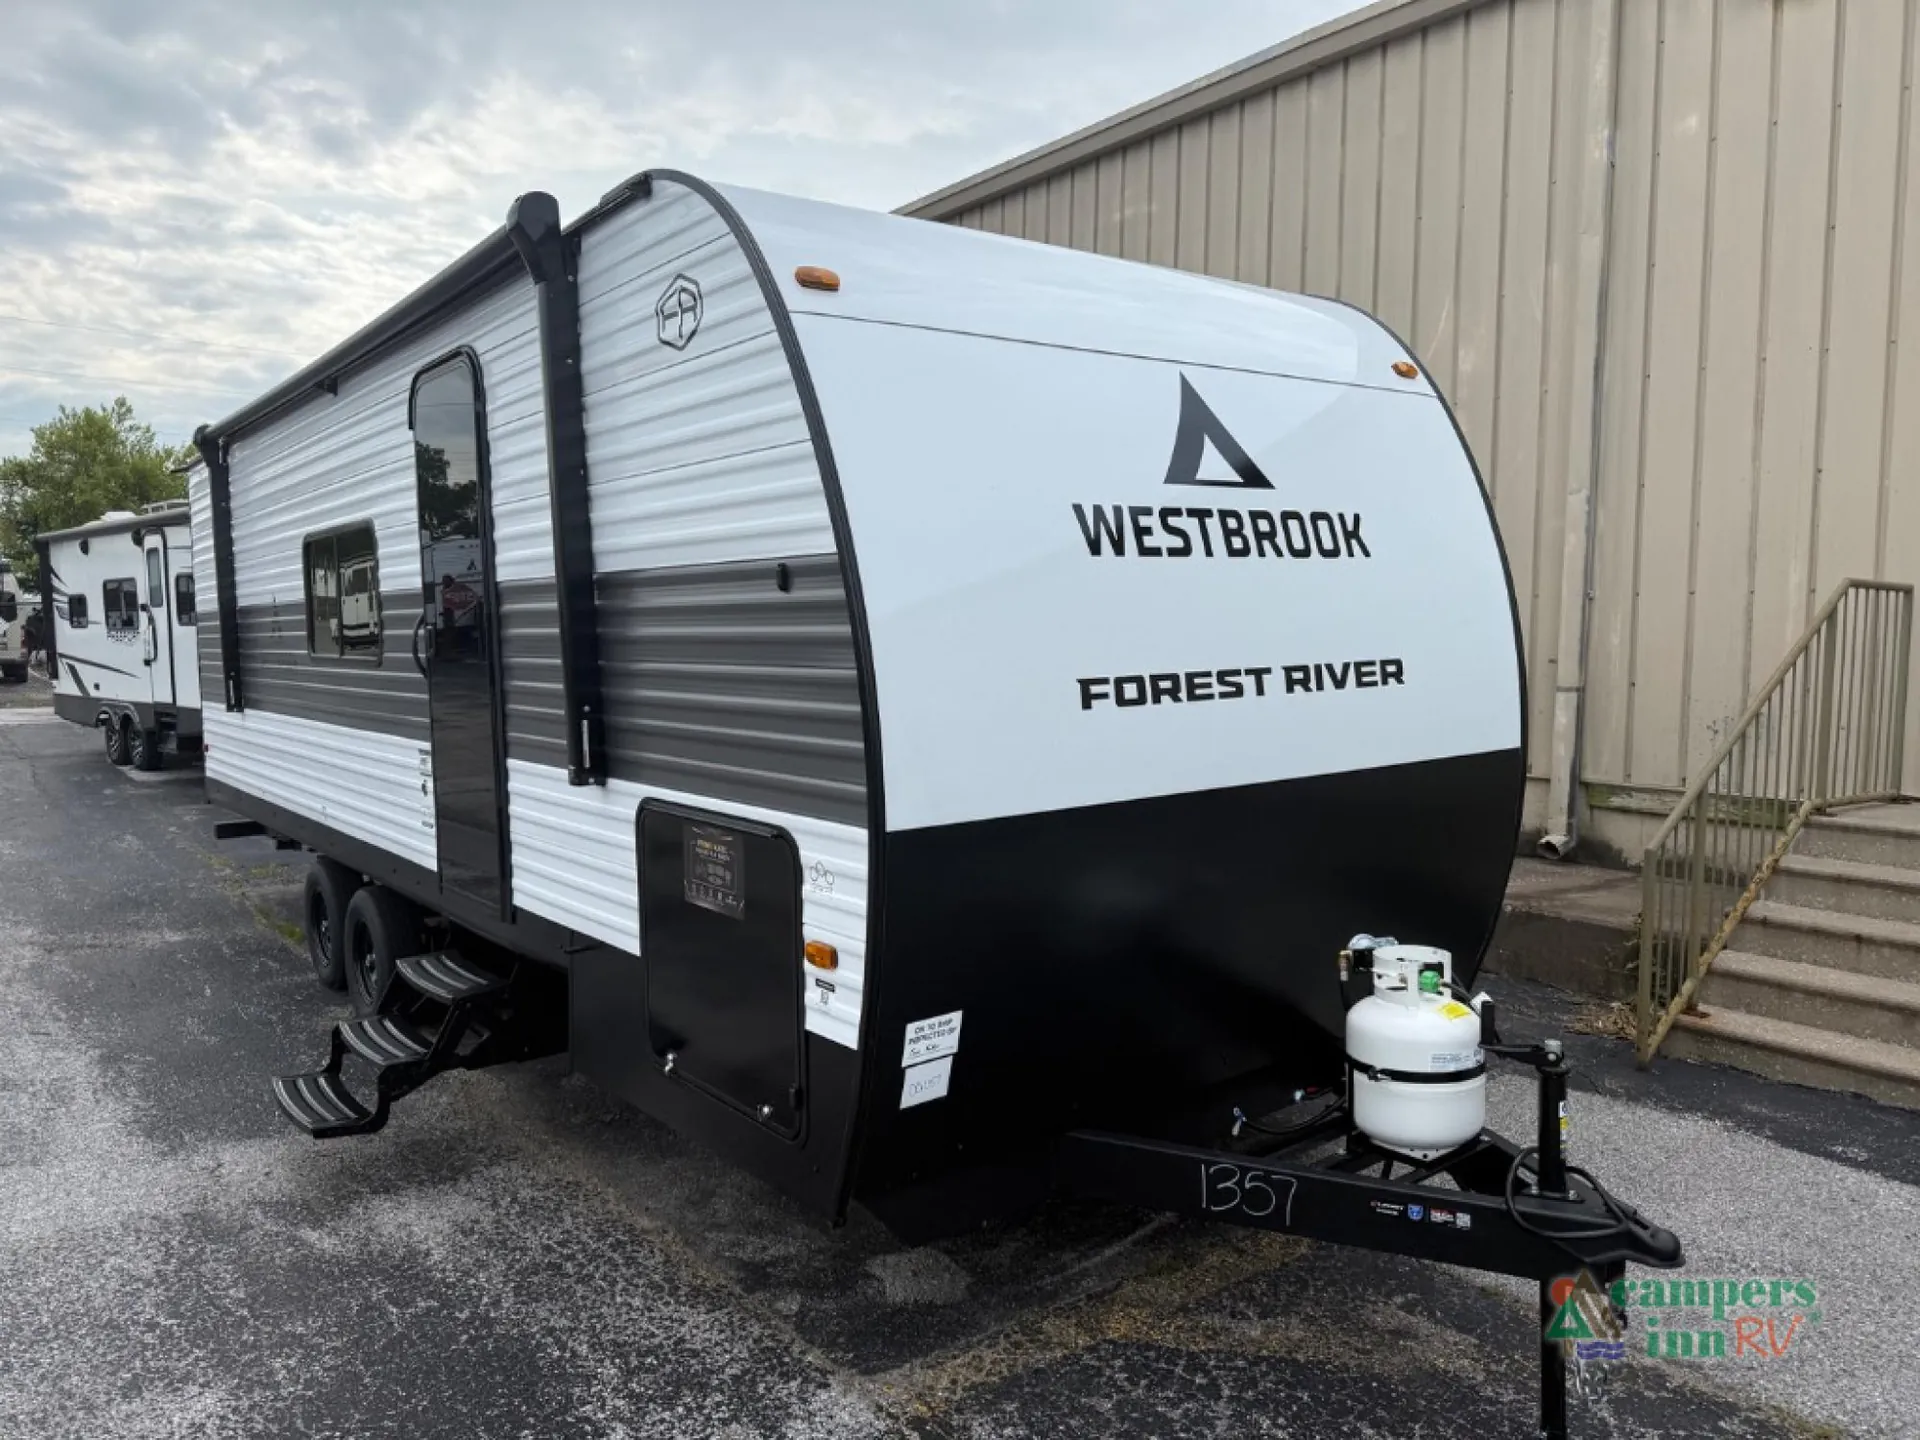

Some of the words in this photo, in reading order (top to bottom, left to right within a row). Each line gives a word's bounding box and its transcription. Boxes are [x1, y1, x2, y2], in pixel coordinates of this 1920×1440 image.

[1072, 503, 1371, 559] WESTBROOK
[1077, 666, 1272, 710] FOREST
[1281, 658, 1405, 694] RIVER
[1201, 1163, 1298, 1227] 1357
